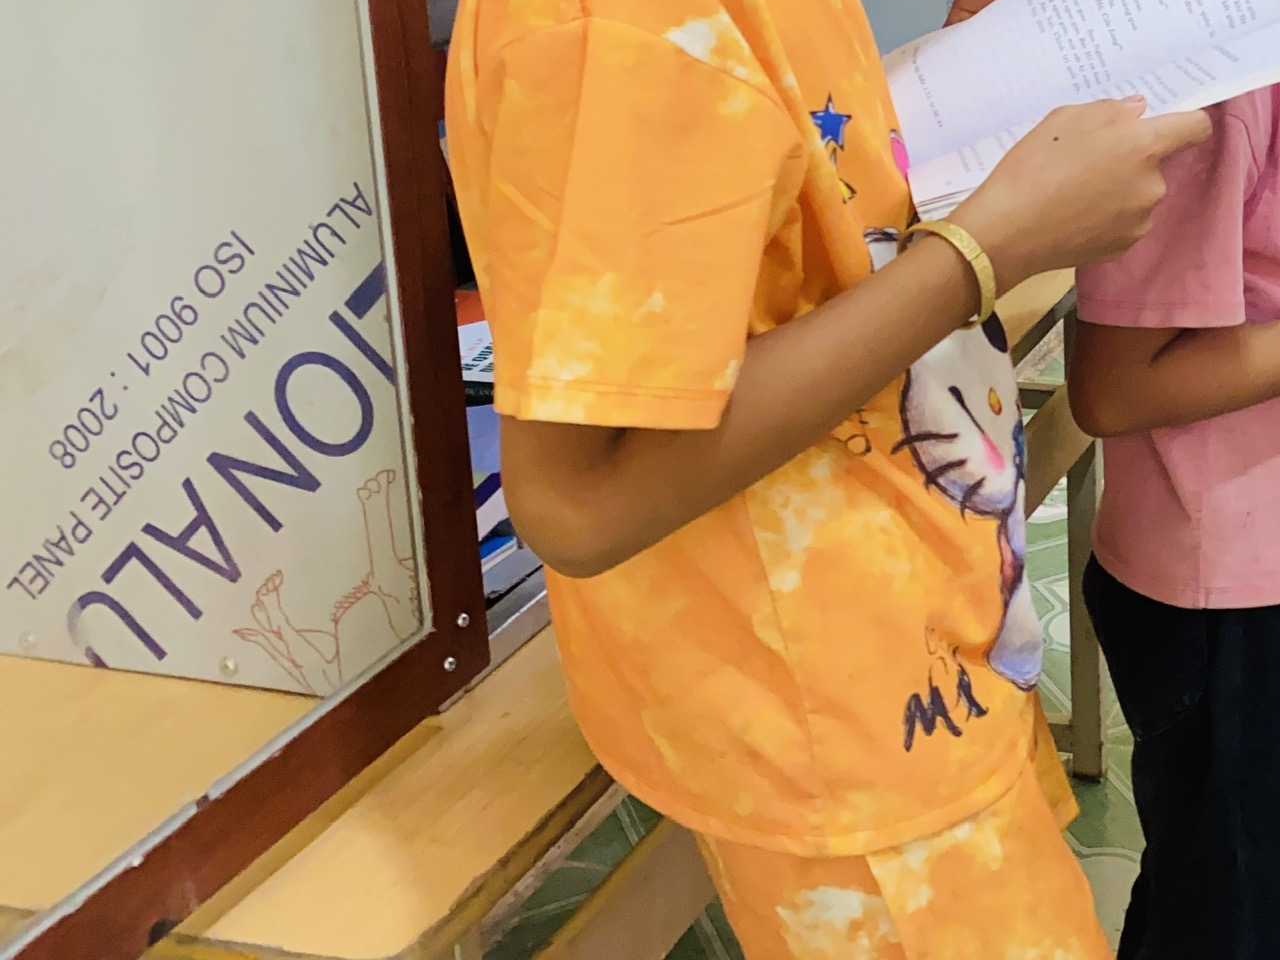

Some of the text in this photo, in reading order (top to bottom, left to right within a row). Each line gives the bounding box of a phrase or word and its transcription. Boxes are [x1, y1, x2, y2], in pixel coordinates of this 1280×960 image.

[193, 230, 257, 301] ISO
[126, 294, 200, 379] 9001
[5, 181, 375, 602] ALUMINIUM COMPOSITE PANEL
[48, 386, 119, 470] 2008
